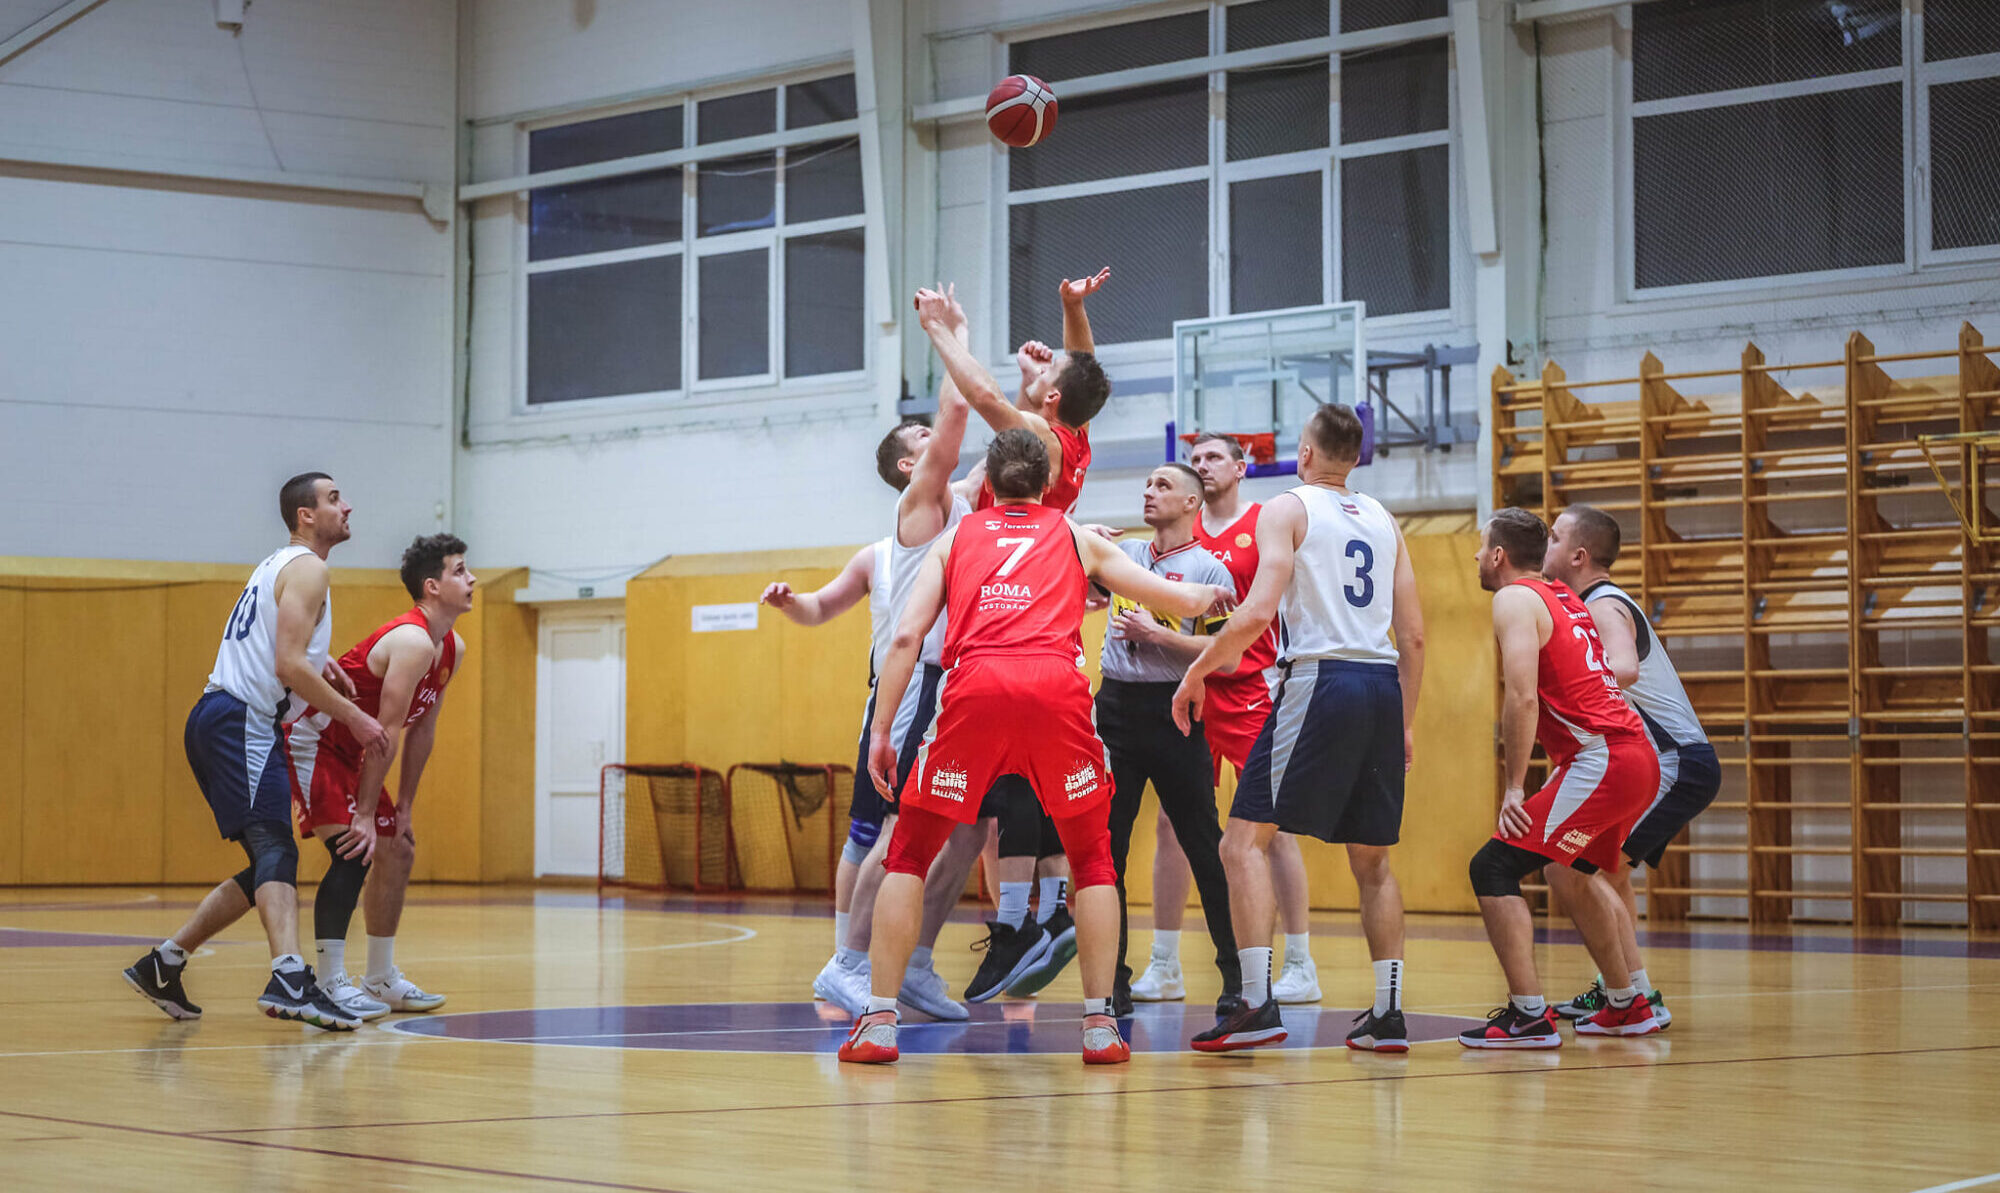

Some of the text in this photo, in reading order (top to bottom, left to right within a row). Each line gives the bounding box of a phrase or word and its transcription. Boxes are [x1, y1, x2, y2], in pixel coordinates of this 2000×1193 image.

[996, 537, 1036, 577] 7
[1343, 539, 1374, 608] 3
[224, 585, 258, 641] 10
[980, 582, 1032, 598] ROMA
